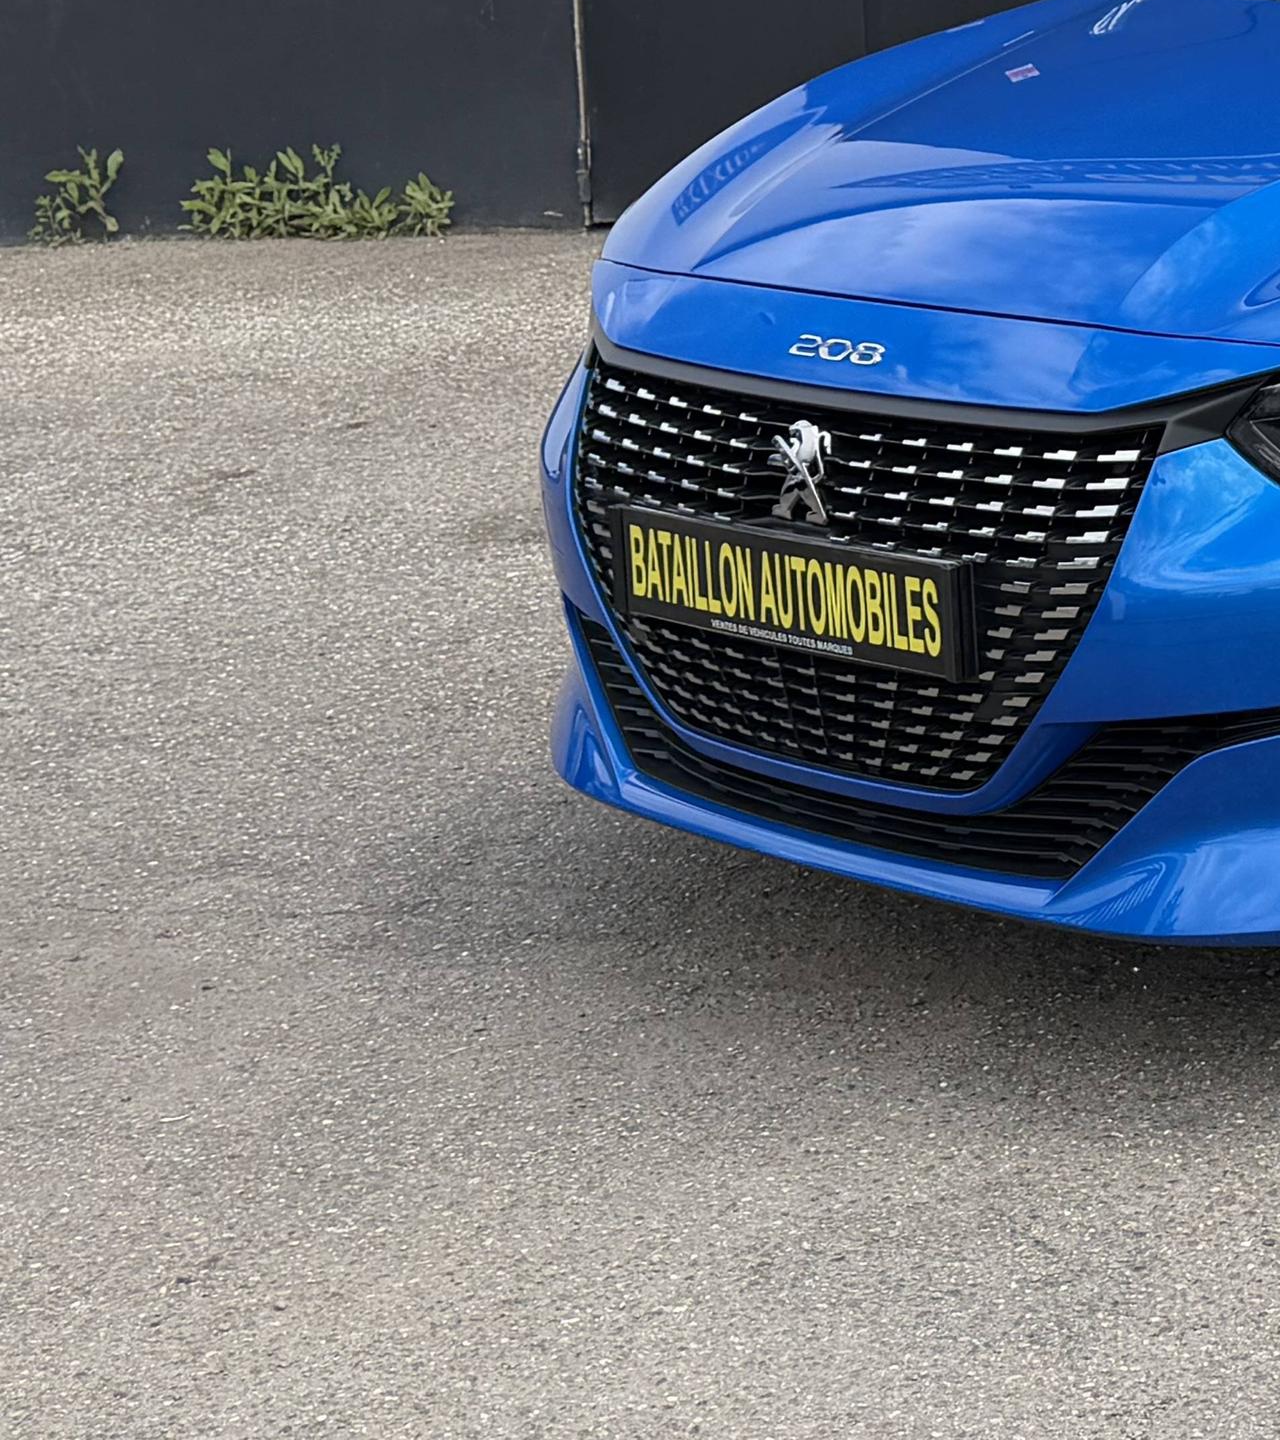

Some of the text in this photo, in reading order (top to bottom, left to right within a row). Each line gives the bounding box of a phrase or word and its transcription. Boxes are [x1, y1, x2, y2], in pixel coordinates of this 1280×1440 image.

[788, 333, 886, 365] 208
[629, 523, 942, 658] BATAILLON AUTOMOBILES
[710, 617, 738, 633] VENTES
[738, 623, 748, 635] DE
[788, 634, 816, 649] TOUTES
[816, 639, 854, 657] MARQUES
